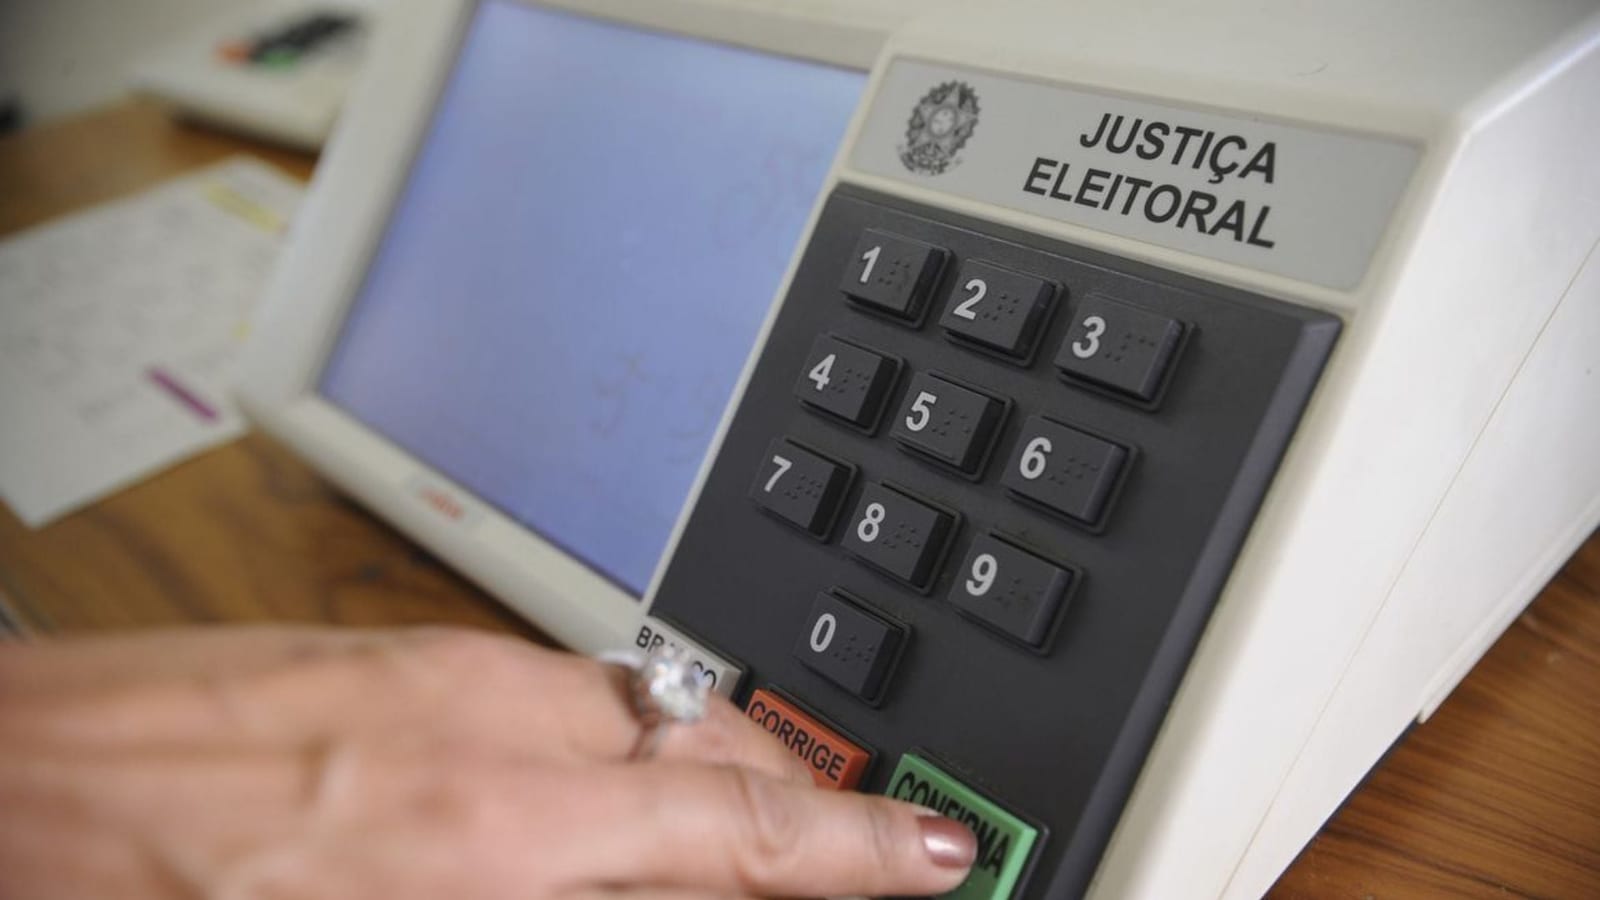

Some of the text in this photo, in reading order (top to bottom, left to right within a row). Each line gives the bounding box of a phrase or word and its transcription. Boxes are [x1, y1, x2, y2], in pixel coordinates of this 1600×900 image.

[1079, 113, 1277, 184] JUSTIÇA
[1022, 157, 1276, 249] ELEITORAL
[861, 247, 881, 282] 1
[954, 279, 987, 319] 2
[1072, 316, 1106, 358] 3
[809, 354, 836, 390] 4
[905, 392, 936, 431] 5
[764, 455, 792, 492] 7
[1019, 437, 1051, 479] 6
[857, 502, 886, 542] 8
[966, 554, 997, 596] 9
[810, 613, 836, 653] 0
[749, 700, 846, 782] CORRIGE
